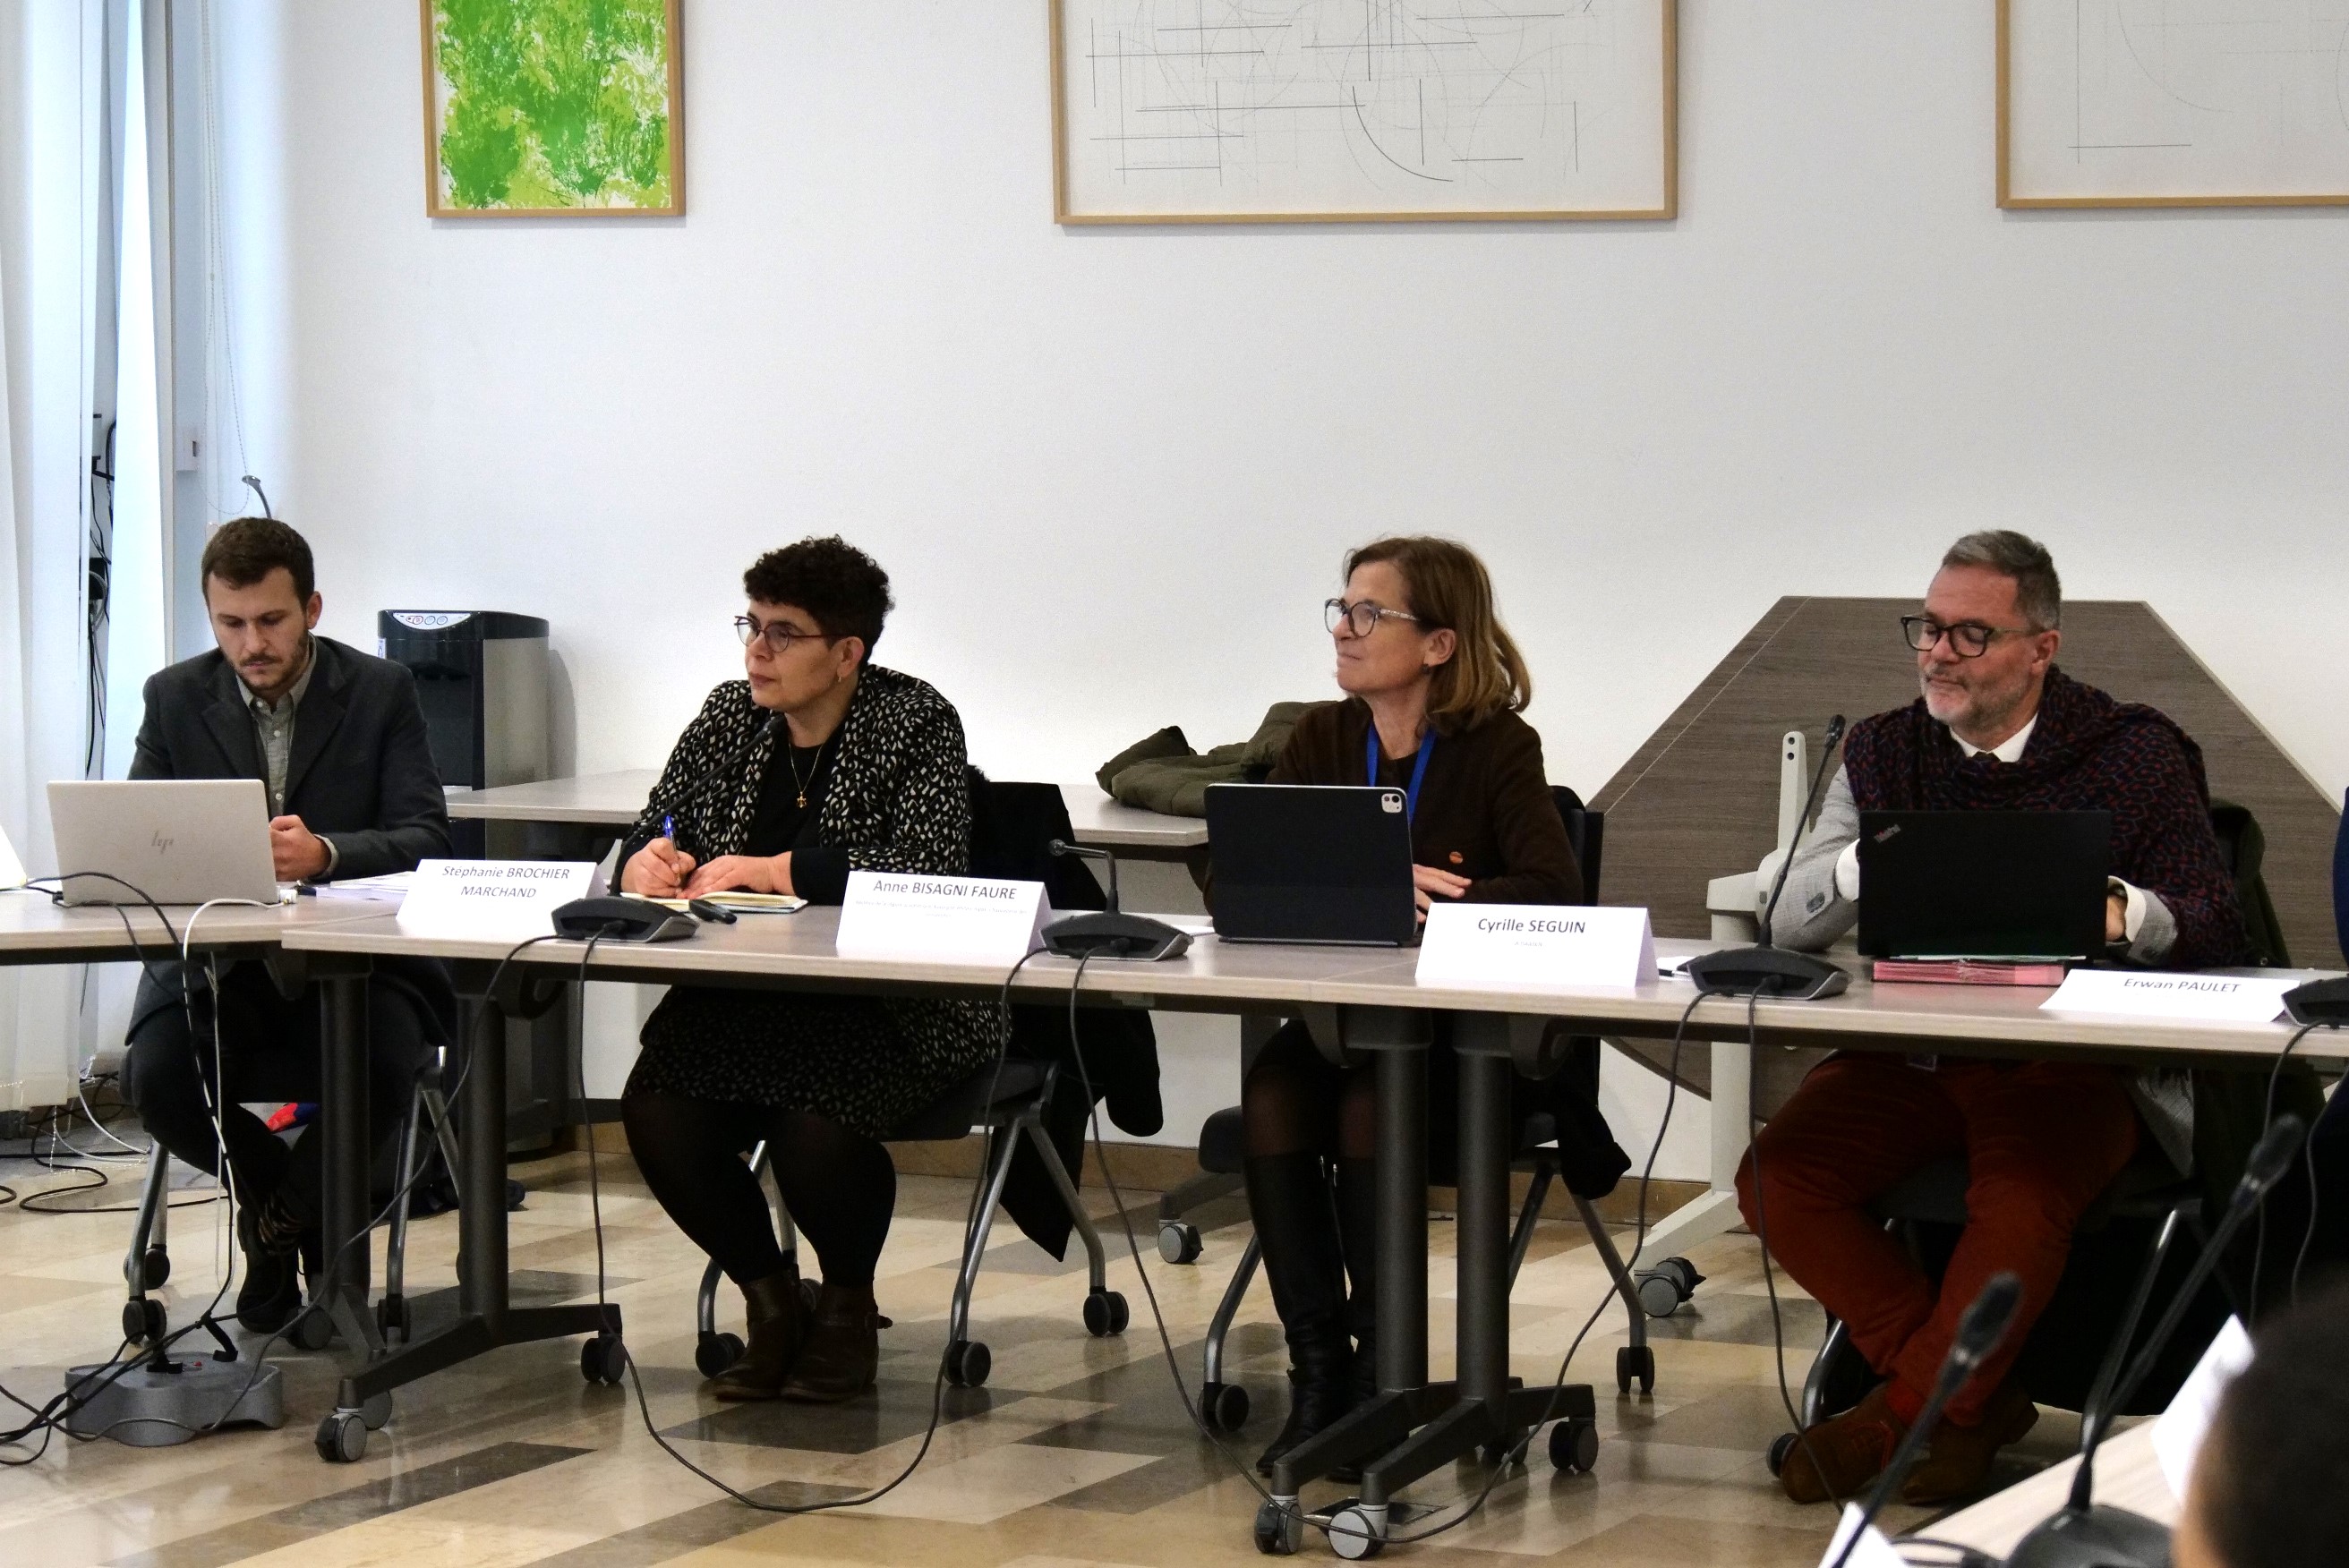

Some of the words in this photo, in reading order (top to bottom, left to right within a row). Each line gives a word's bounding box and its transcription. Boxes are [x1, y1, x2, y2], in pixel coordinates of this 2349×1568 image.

[442, 865, 503, 879] Stéphanie
[507, 867, 570, 880] BROCHIER
[460, 886, 537, 899] MARCHAND
[873, 880, 909, 893] Anne
[912, 882, 968, 897] BISAGNI
[971, 885, 1017, 899] FAURE
[1478, 918, 1525, 933] Cyrille
[1529, 919, 1586, 933] SEGUIN
[2123, 978, 2174, 989] Erwan
[2178, 981, 2241, 993] PAULET
